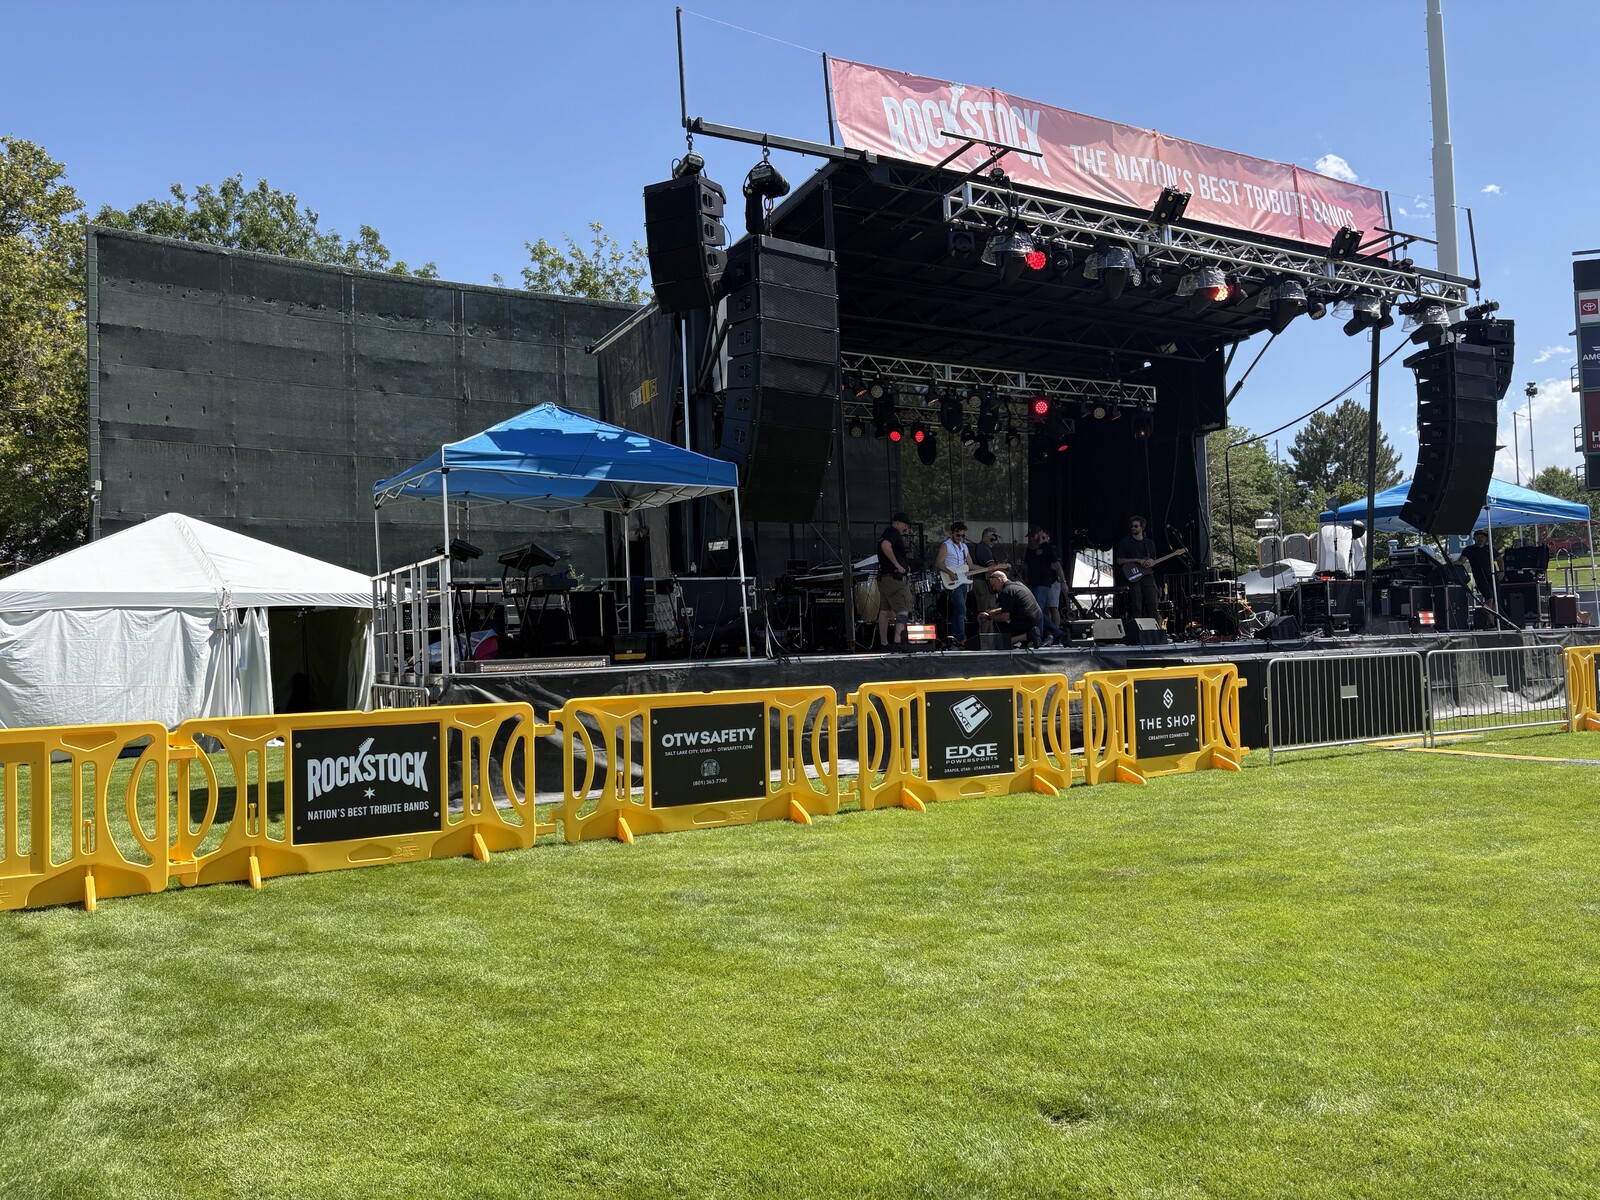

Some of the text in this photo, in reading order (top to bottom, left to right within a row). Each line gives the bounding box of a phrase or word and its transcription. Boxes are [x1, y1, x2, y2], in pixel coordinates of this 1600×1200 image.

[882, 83, 1051, 178] ROCKSTOCK
[1070, 144, 1357, 232] THE NATION'S BEST TRIBUTE BANDS
[955, 707, 973, 730] EDGE
[1139, 714, 1196, 731] THE SHOP
[717, 744, 753, 752] OTWSAFETY.COM
[945, 742, 998, 759] EDGE
[307, 737, 429, 802] ROCKSTOCK
[945, 756, 998, 765] POWERSPORTS
[307, 800, 430, 821] NATION'S BEST TRIBUTE BANDS
